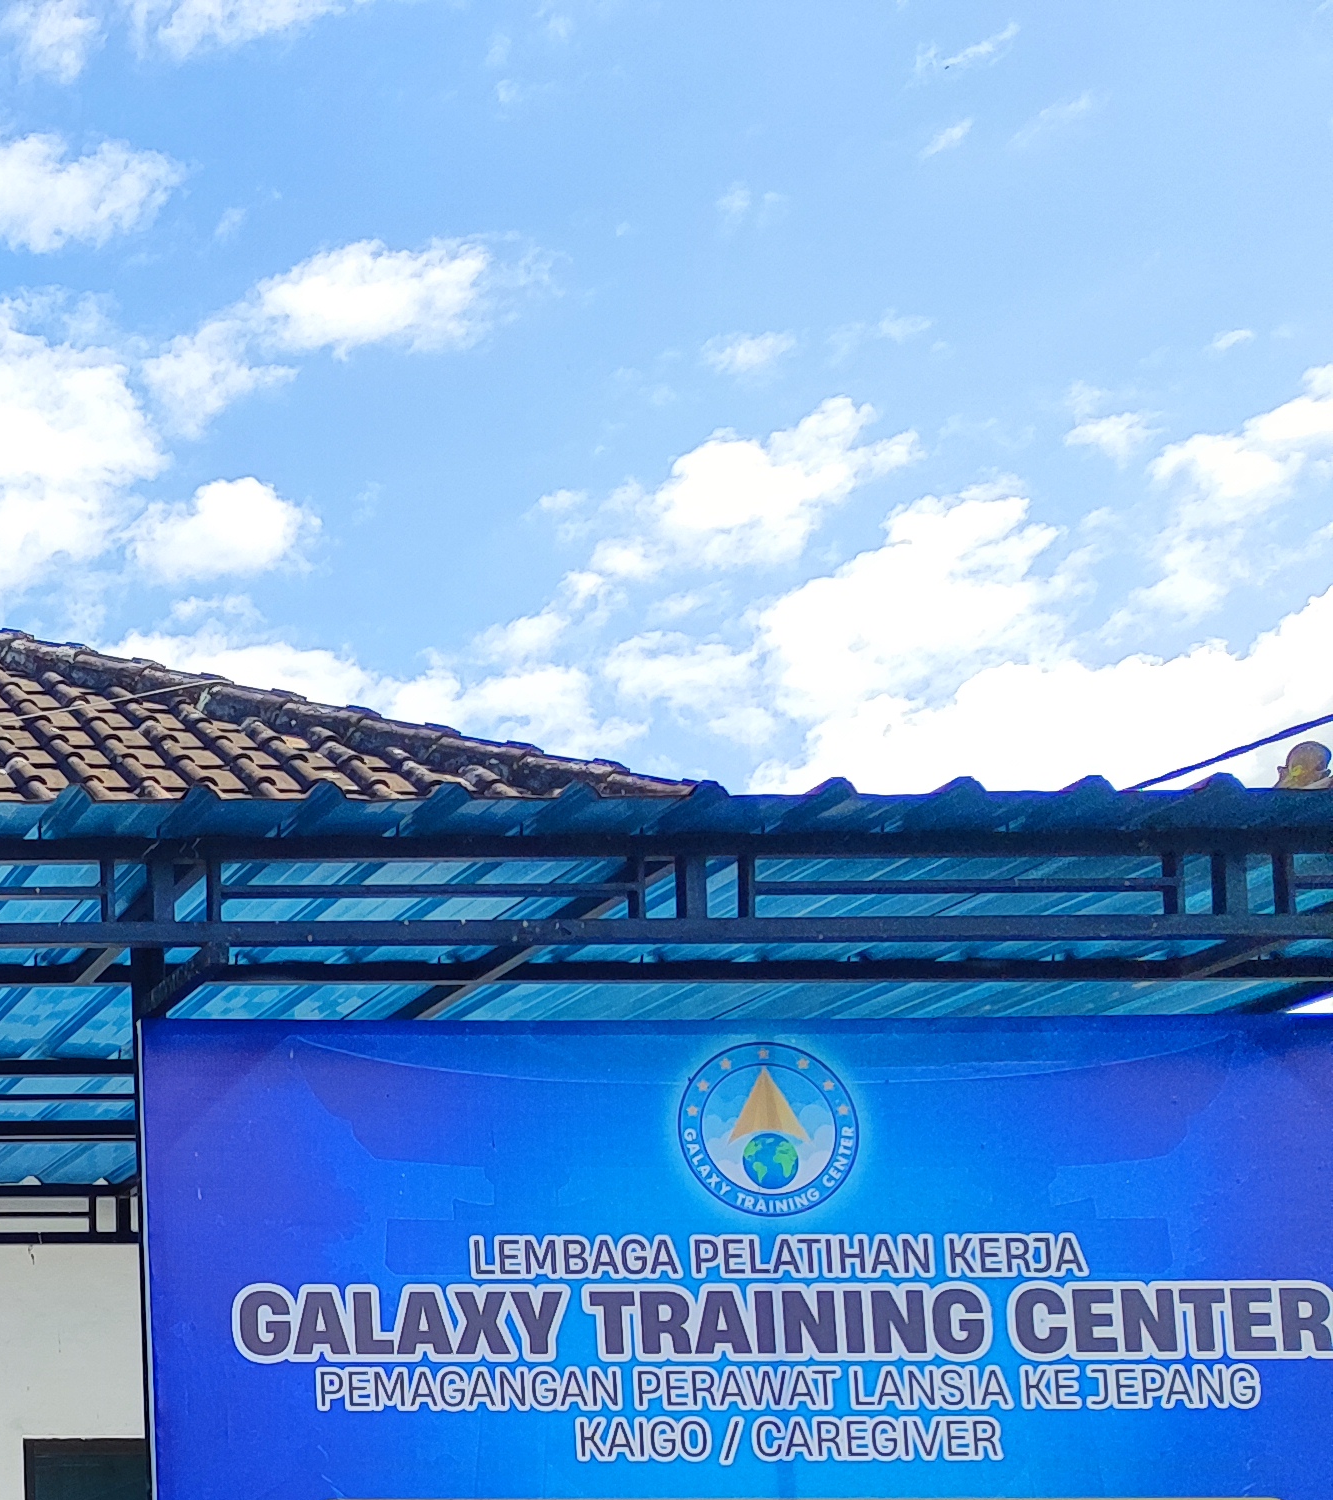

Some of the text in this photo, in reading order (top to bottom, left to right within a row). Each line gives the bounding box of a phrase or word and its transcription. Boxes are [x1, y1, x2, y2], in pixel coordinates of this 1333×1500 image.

[683, 1126, 855, 1213] GALAXY TRAINING CENTER
[473, 1236, 1085, 1275] LEMBAGA PELATIHAN KERJA
[238, 1287, 1333, 1356] GALAXY TRAINING CENTER
[319, 1367, 1257, 1408] PEMAGANGAN PERAWAT LANSIA KE JEPANG
[579, 1420, 999, 1462] KAIGO / CAREGIVER
